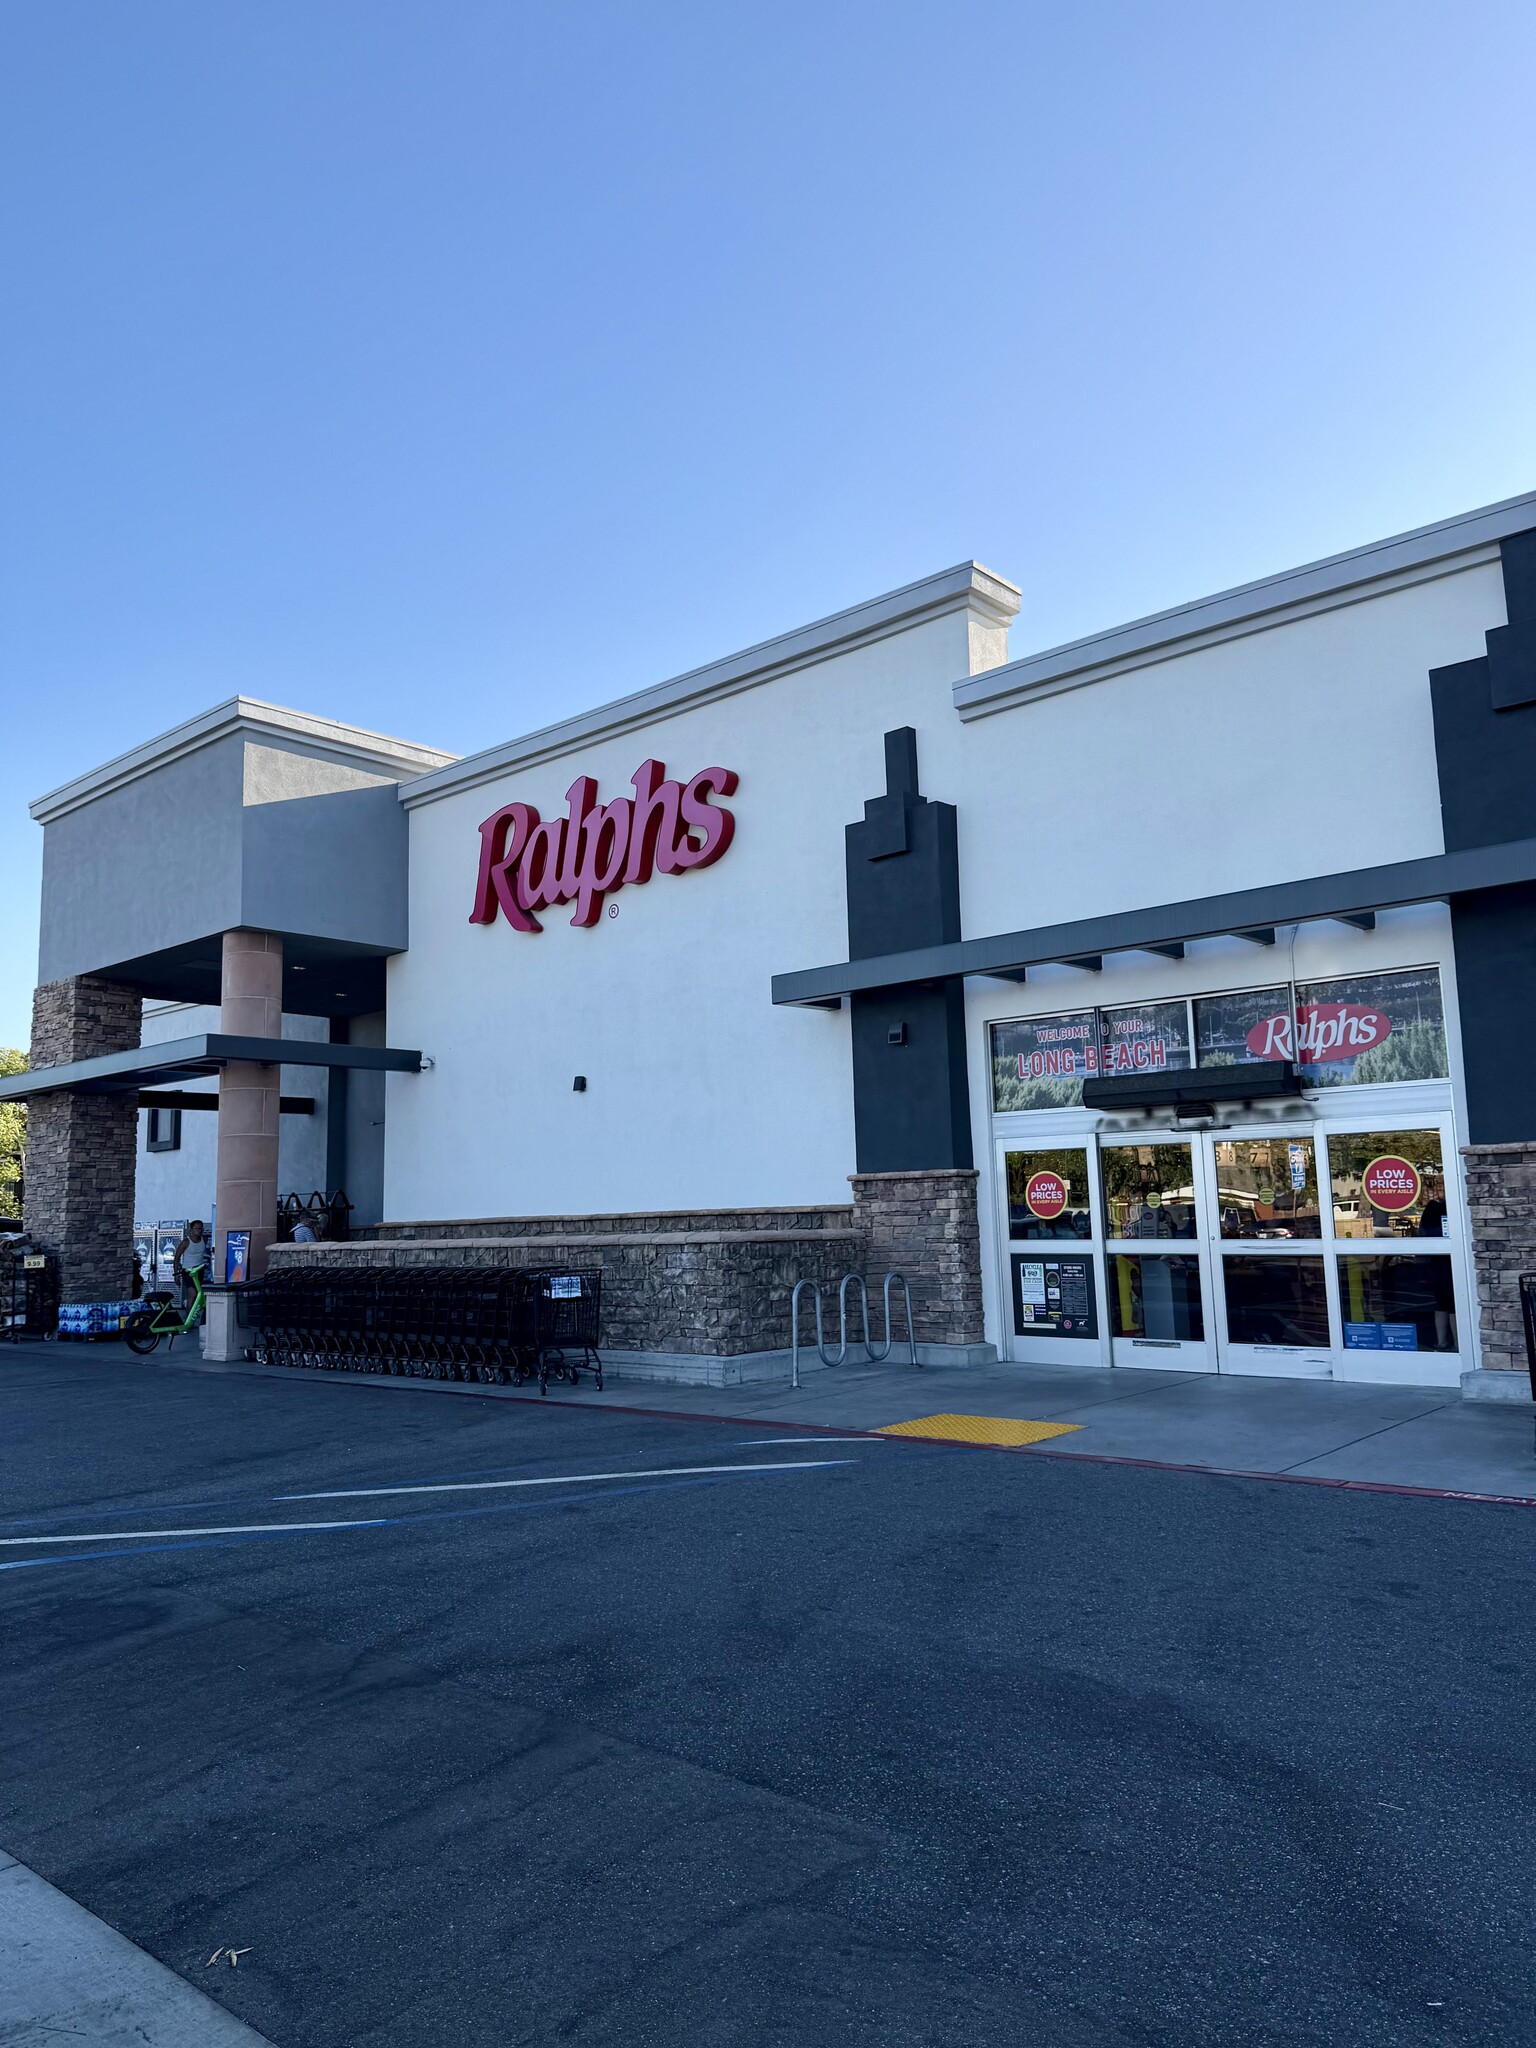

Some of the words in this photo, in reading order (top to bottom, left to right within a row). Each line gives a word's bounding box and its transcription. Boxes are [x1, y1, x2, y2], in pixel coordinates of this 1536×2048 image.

[468, 758, 739, 934] Ralphs
[1036, 1025, 1090, 1043] WELCOME
[1112, 1019, 1143, 1035] YOUR
[1262, 1008, 1378, 1060] Ralphs
[1017, 1048, 1076, 1079] LONG
[1084, 1039, 1167, 1072] BEACH
[1376, 1169, 1406, 1179] LOW
[1035, 1182, 1057, 1191] LOW
[1369, 1179, 1414, 1189] PRICES
[1030, 1191, 1063, 1200] PRICES
